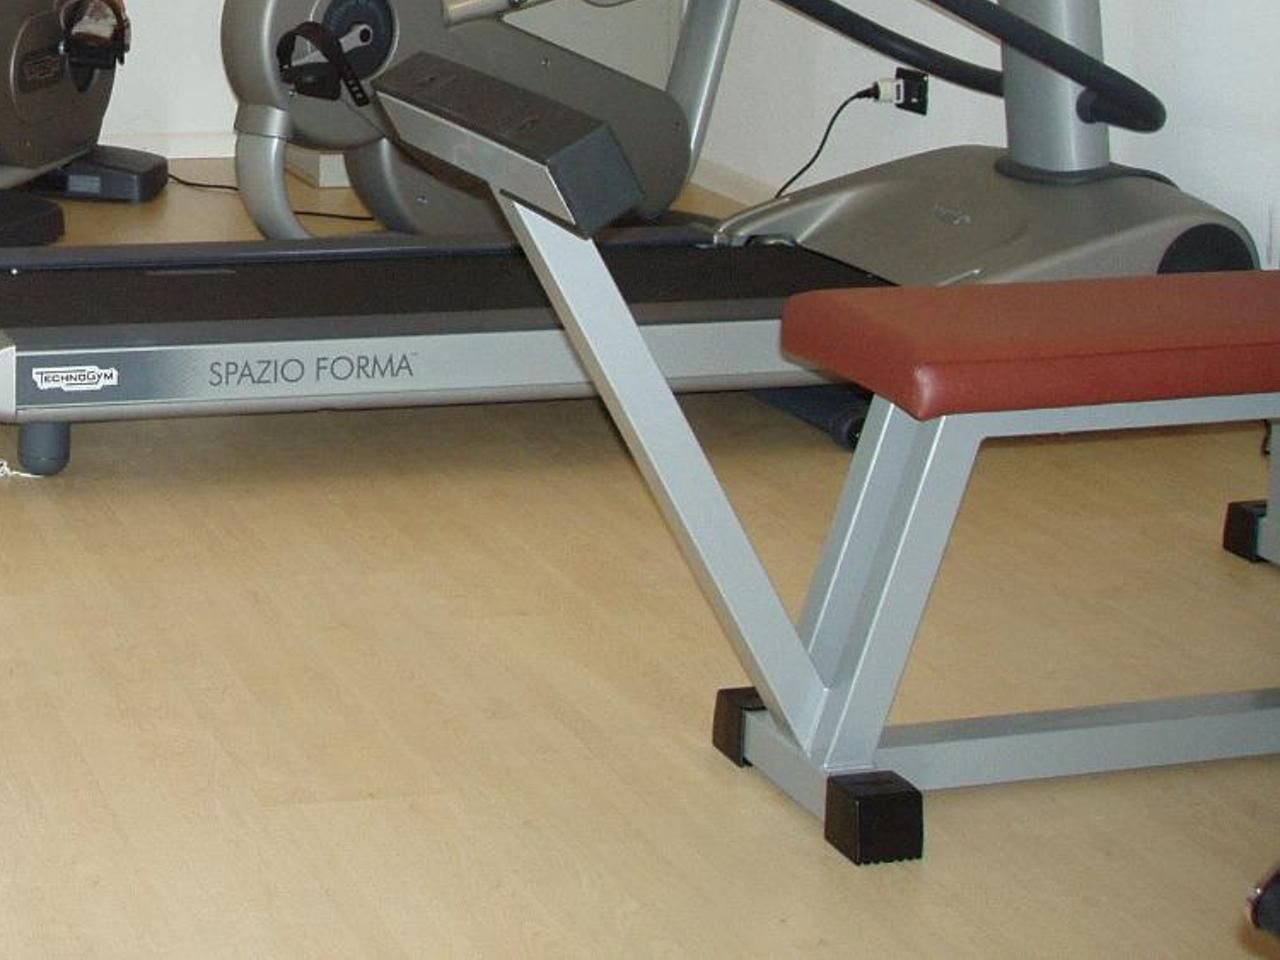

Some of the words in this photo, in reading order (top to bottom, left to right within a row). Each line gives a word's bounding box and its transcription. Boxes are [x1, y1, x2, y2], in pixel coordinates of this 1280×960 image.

[34, 368, 114, 387] TECHNOGYM
[208, 358, 305, 386] SPAZIO
[316, 353, 414, 381] FORMA
